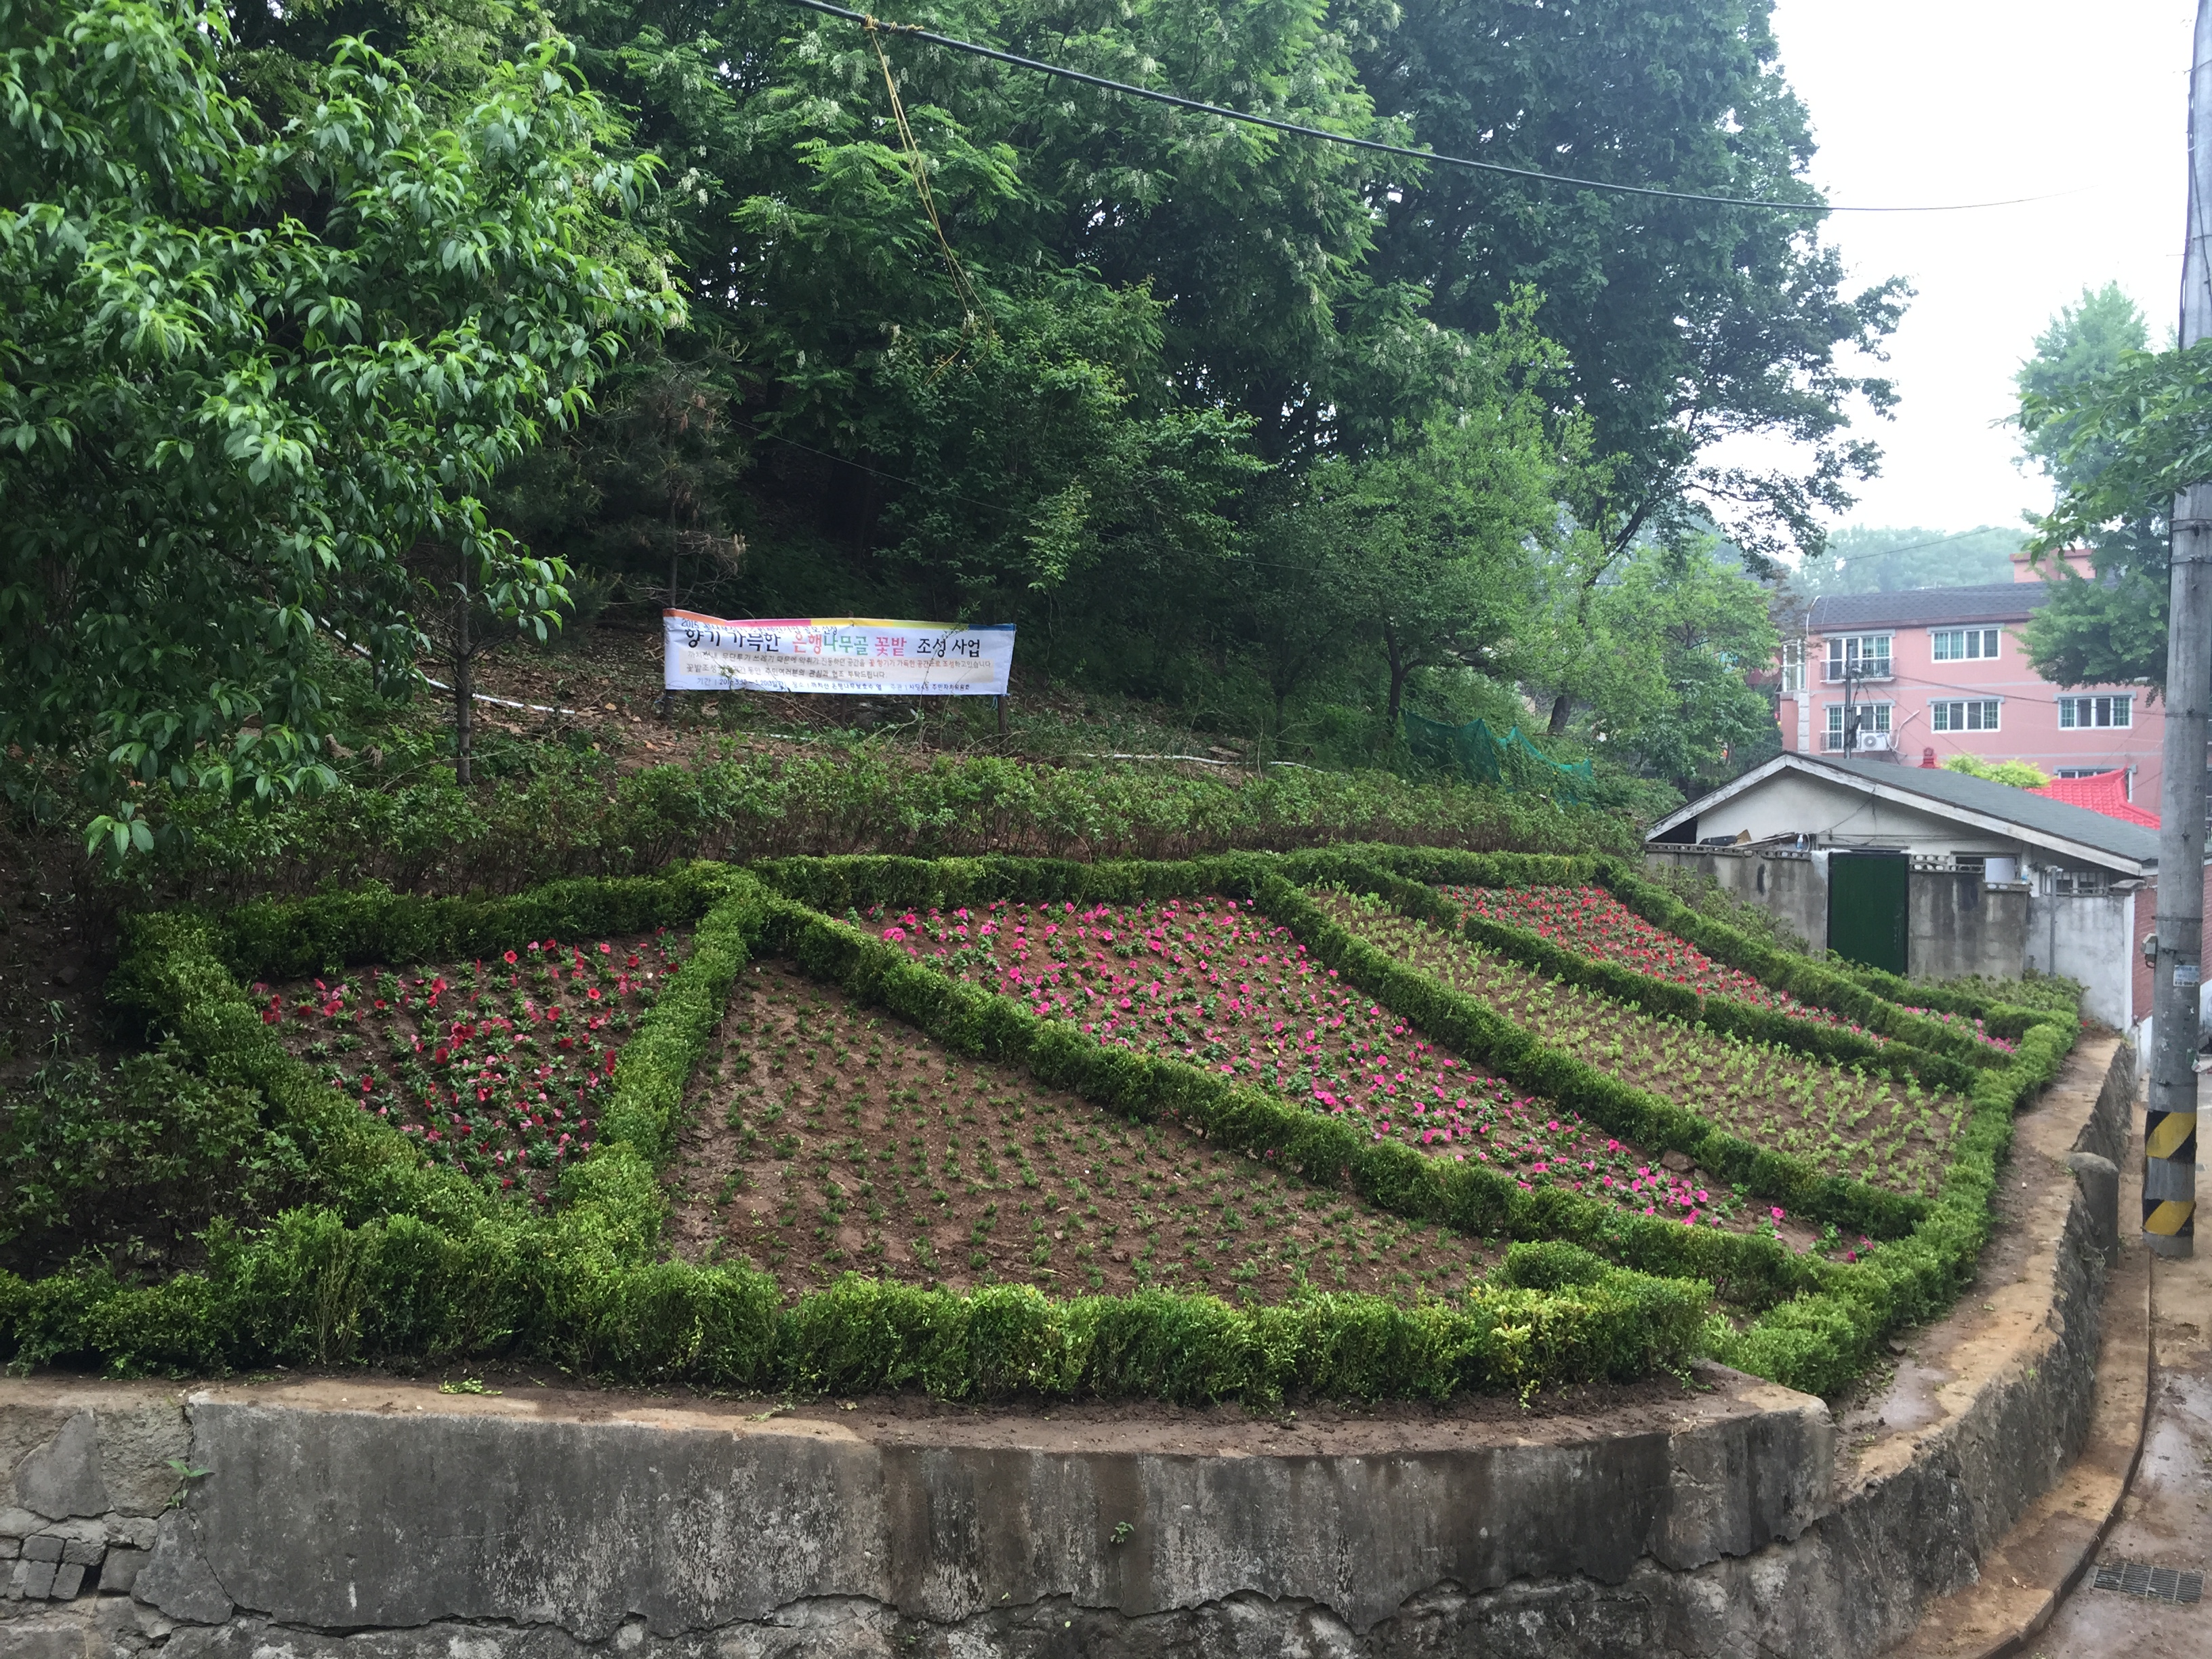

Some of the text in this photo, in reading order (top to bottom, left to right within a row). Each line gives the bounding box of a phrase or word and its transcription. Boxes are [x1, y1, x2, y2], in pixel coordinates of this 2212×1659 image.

[792, 632, 869, 656] 은행나무골
[874, 636, 907, 657] 꽃밭
[917, 638, 947, 658] 조성
[951, 638, 981, 658] 사업
[848, 658, 865, 667] 공간을
